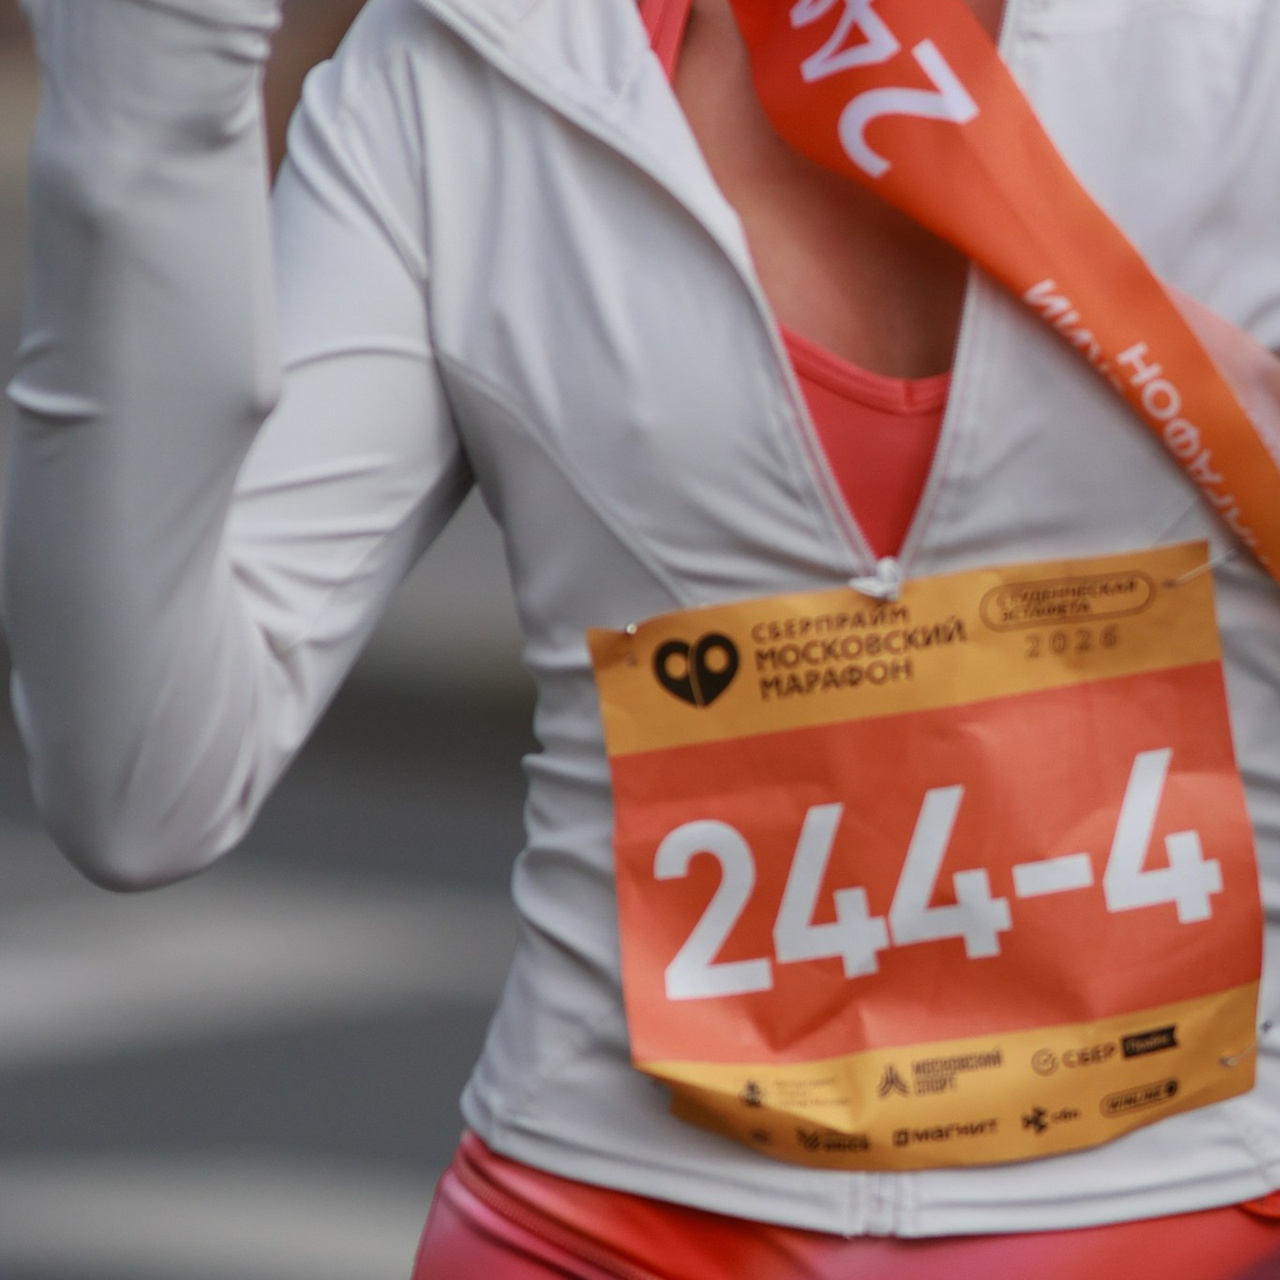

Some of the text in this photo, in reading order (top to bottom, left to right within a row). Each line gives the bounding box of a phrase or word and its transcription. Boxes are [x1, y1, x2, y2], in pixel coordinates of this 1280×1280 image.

[750, 604, 910, 645] СБЕРПРАЙМ
[755, 615, 967, 671] МОСКОВСКИЙ
[760, 657, 914, 701] МАРАФОН
[653, 746, 1224, 1000] 244-4
[1062, 1042, 1115, 1067] СБЕР
